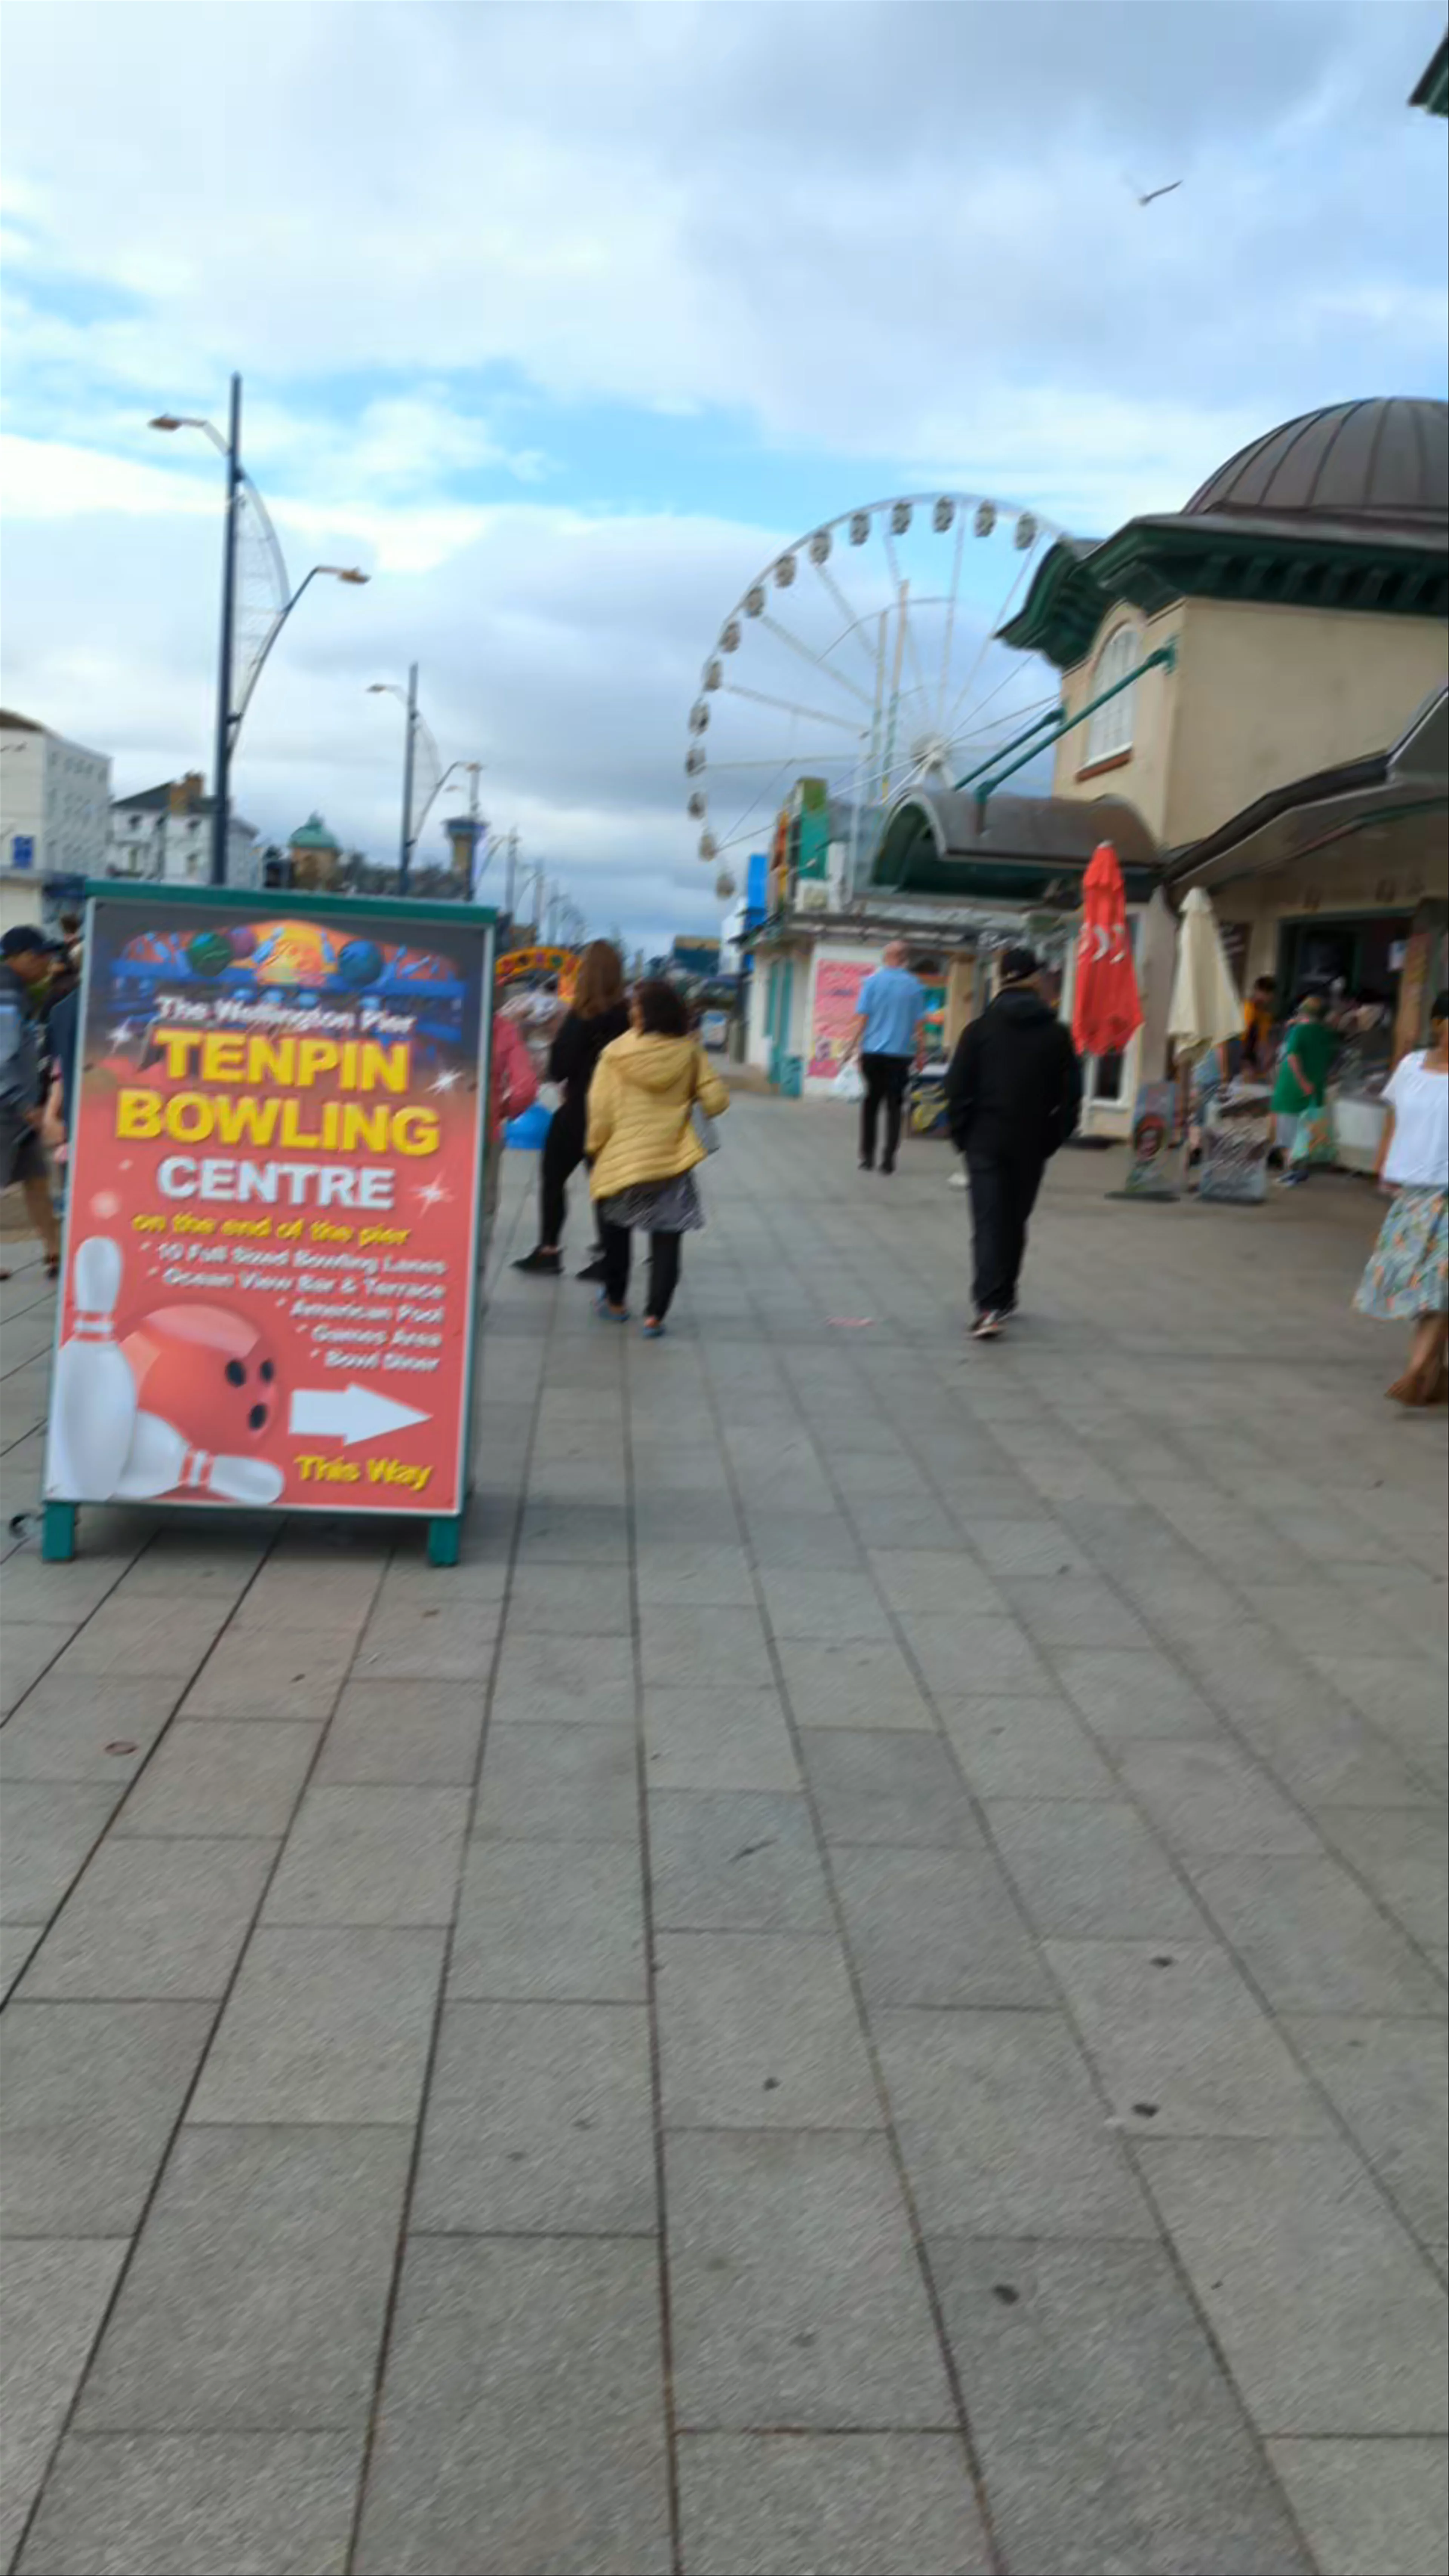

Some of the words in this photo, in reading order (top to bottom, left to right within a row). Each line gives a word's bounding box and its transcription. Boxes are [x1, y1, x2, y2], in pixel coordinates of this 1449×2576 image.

[155, 1029, 410, 1093] TENPIN
[115, 1088, 440, 1156] BOWLING
[157, 1155, 396, 1209] CENTRE
[133, 1214, 166, 1232] on
[173, 1213, 217, 1234] the
[221, 1216, 272, 1237] end
[277, 1218, 305, 1239] of
[311, 1220, 354, 1243] the
[359, 1223, 411, 1249] pier
[294, 1250, 378, 1276] Bowling
[382, 1255, 446, 1275] Lanes
[163, 1268, 235, 1287] Ocean
[239, 1272, 294, 1290] View
[298, 1274, 335, 1292] Bar
[363, 1278, 446, 1299] Terrace
[311, 1325, 388, 1344] Games
[294, 1455, 361, 1482] This
[367, 1458, 434, 1492] Way
